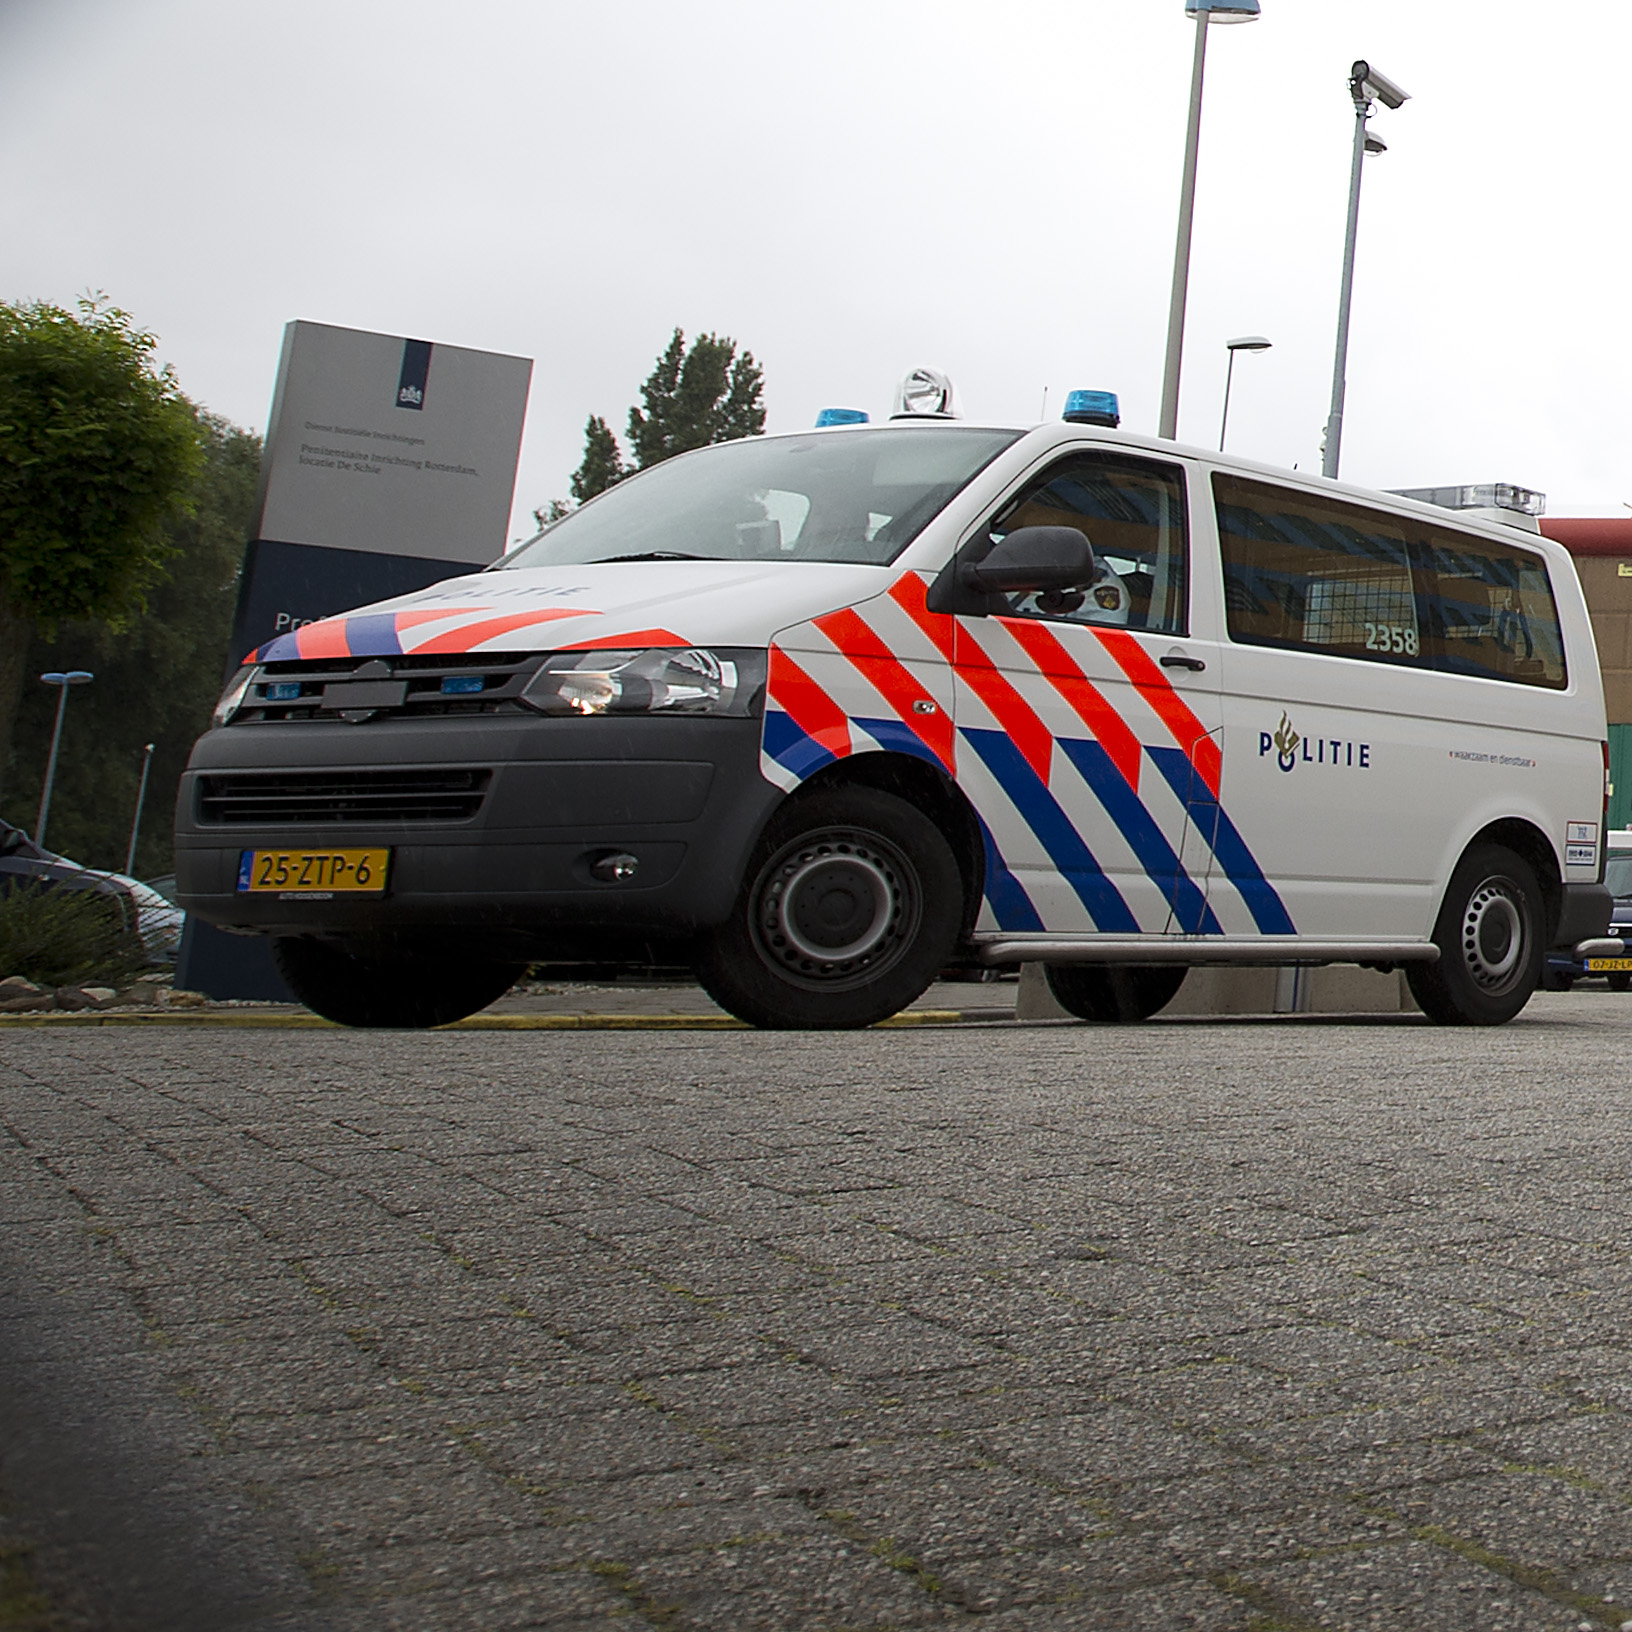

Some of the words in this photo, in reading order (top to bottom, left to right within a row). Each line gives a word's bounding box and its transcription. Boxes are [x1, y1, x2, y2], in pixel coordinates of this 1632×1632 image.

[1365, 622, 1416, 656] 2358
[1259, 731, 1370, 773] POLITIE
[258, 854, 371, 885] 25-ZTP-6
